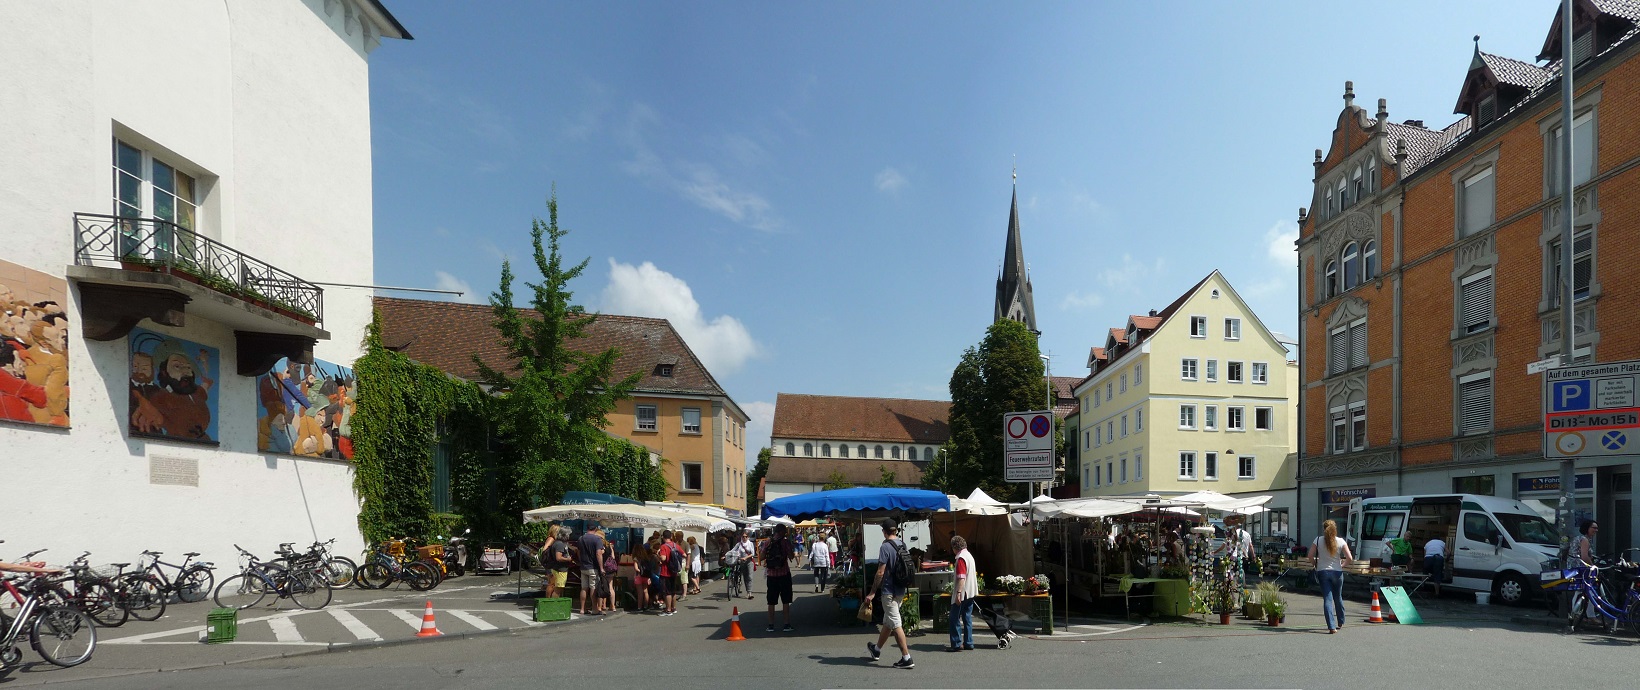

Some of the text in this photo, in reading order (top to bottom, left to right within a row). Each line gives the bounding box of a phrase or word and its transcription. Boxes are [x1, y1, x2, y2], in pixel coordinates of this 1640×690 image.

[1548, 363, 1640, 379] Auf dem gesamten Platz
[1562, 384, 1582, 408] P
[1551, 418, 1565, 428] Di
[1588, 416, 1609, 426] Mo
[1610, 414, 1626, 425] 15
[1628, 414, 1637, 424] h
[1340, 488, 1368, 496] Fahrschule
